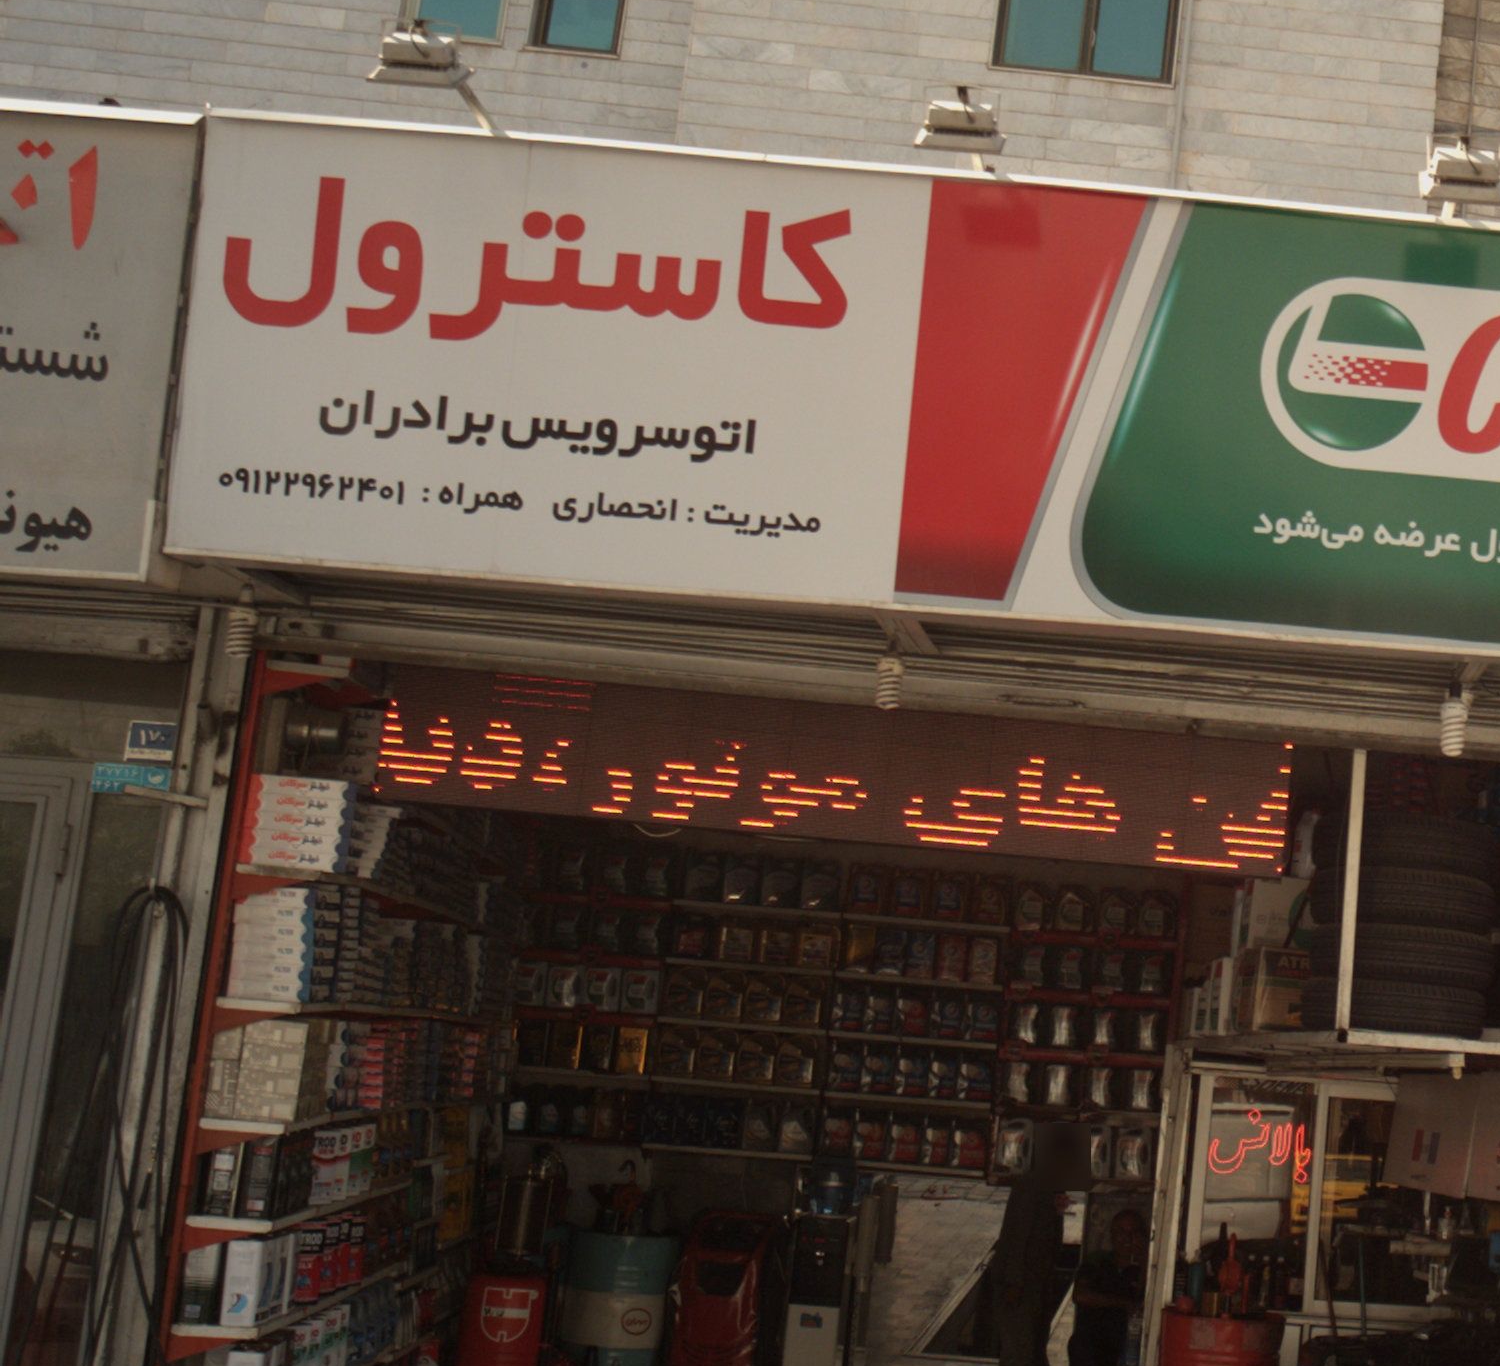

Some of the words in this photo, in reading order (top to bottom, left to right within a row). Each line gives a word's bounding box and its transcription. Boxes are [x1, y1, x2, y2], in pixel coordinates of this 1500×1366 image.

[222, 176, 852, 341] کاسترول
[318, 389, 495, 446] برادران
[501, 416, 757, 463] اتوسرویس
[218, 467, 405, 505] ۰۹۱۲۲۹۶۲۴۰۱
[1372, 521, 1461, 557] عرضه
[1208, 1107, 1311, 1184] بالانس
